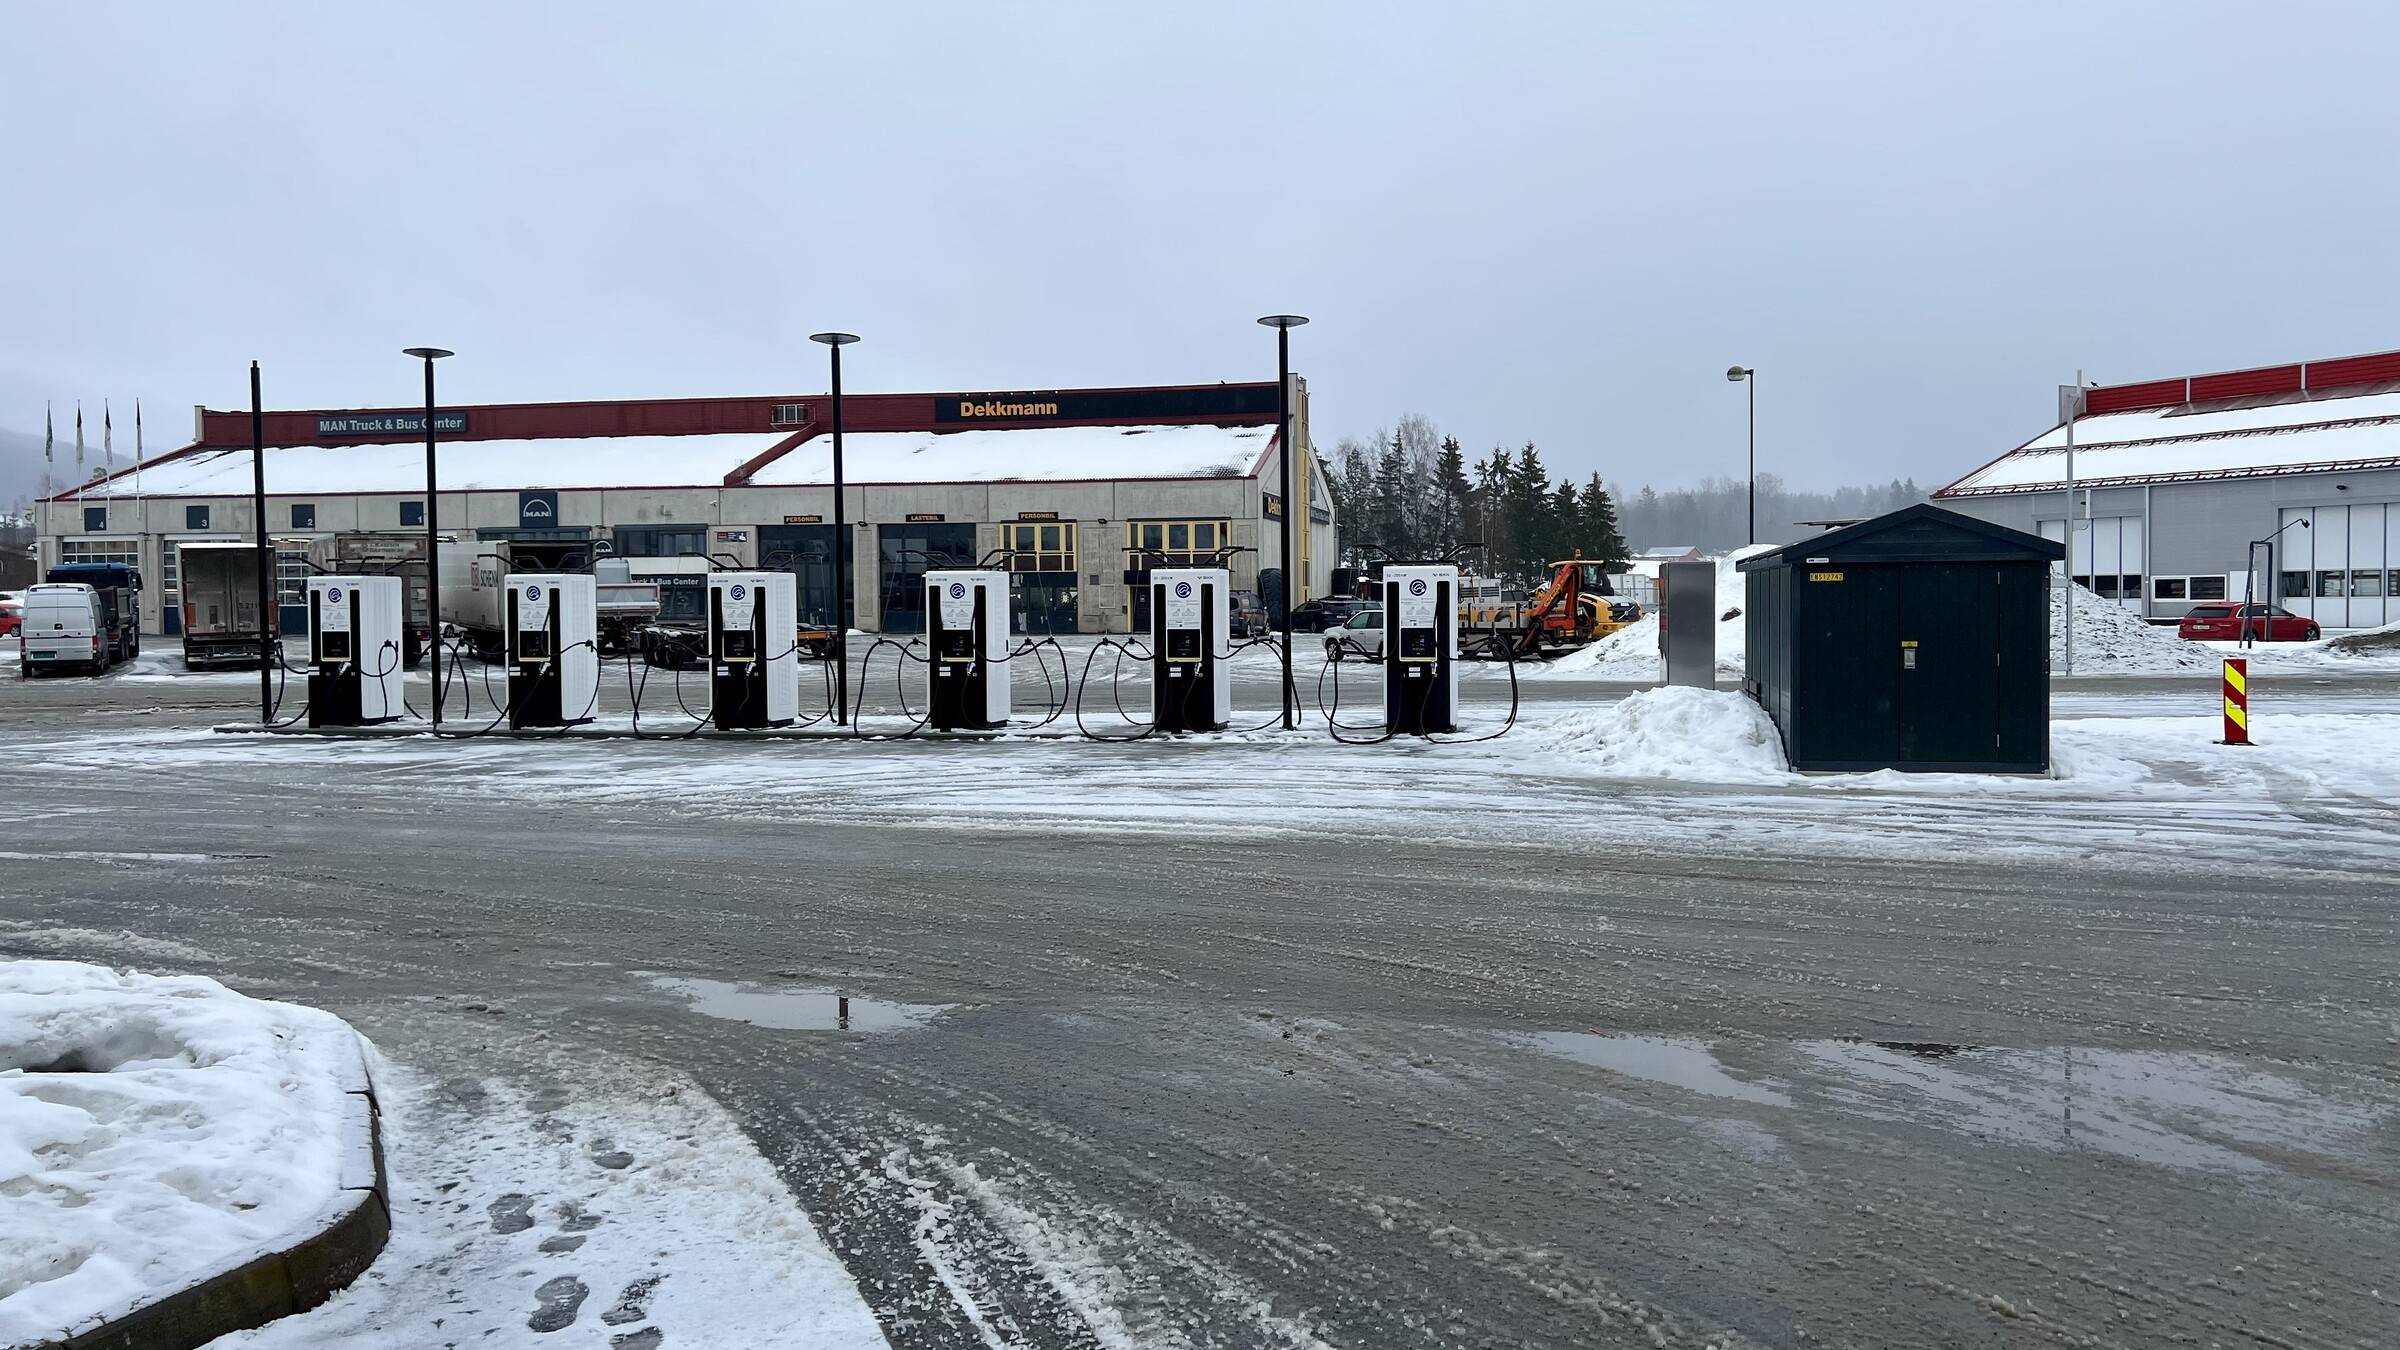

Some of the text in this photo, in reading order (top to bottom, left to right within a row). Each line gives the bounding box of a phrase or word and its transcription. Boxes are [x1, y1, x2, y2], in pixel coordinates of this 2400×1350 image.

[960, 401, 1058, 417] Dekkmann
[319, 417, 463, 432] MAN Truck & Bus Cnter
[201, 519, 207, 527] 3
[307, 518, 313, 526] 2
[417, 516, 422, 524] 1
[98, 521, 105, 529] 4
[673, 577, 700, 585] Center
